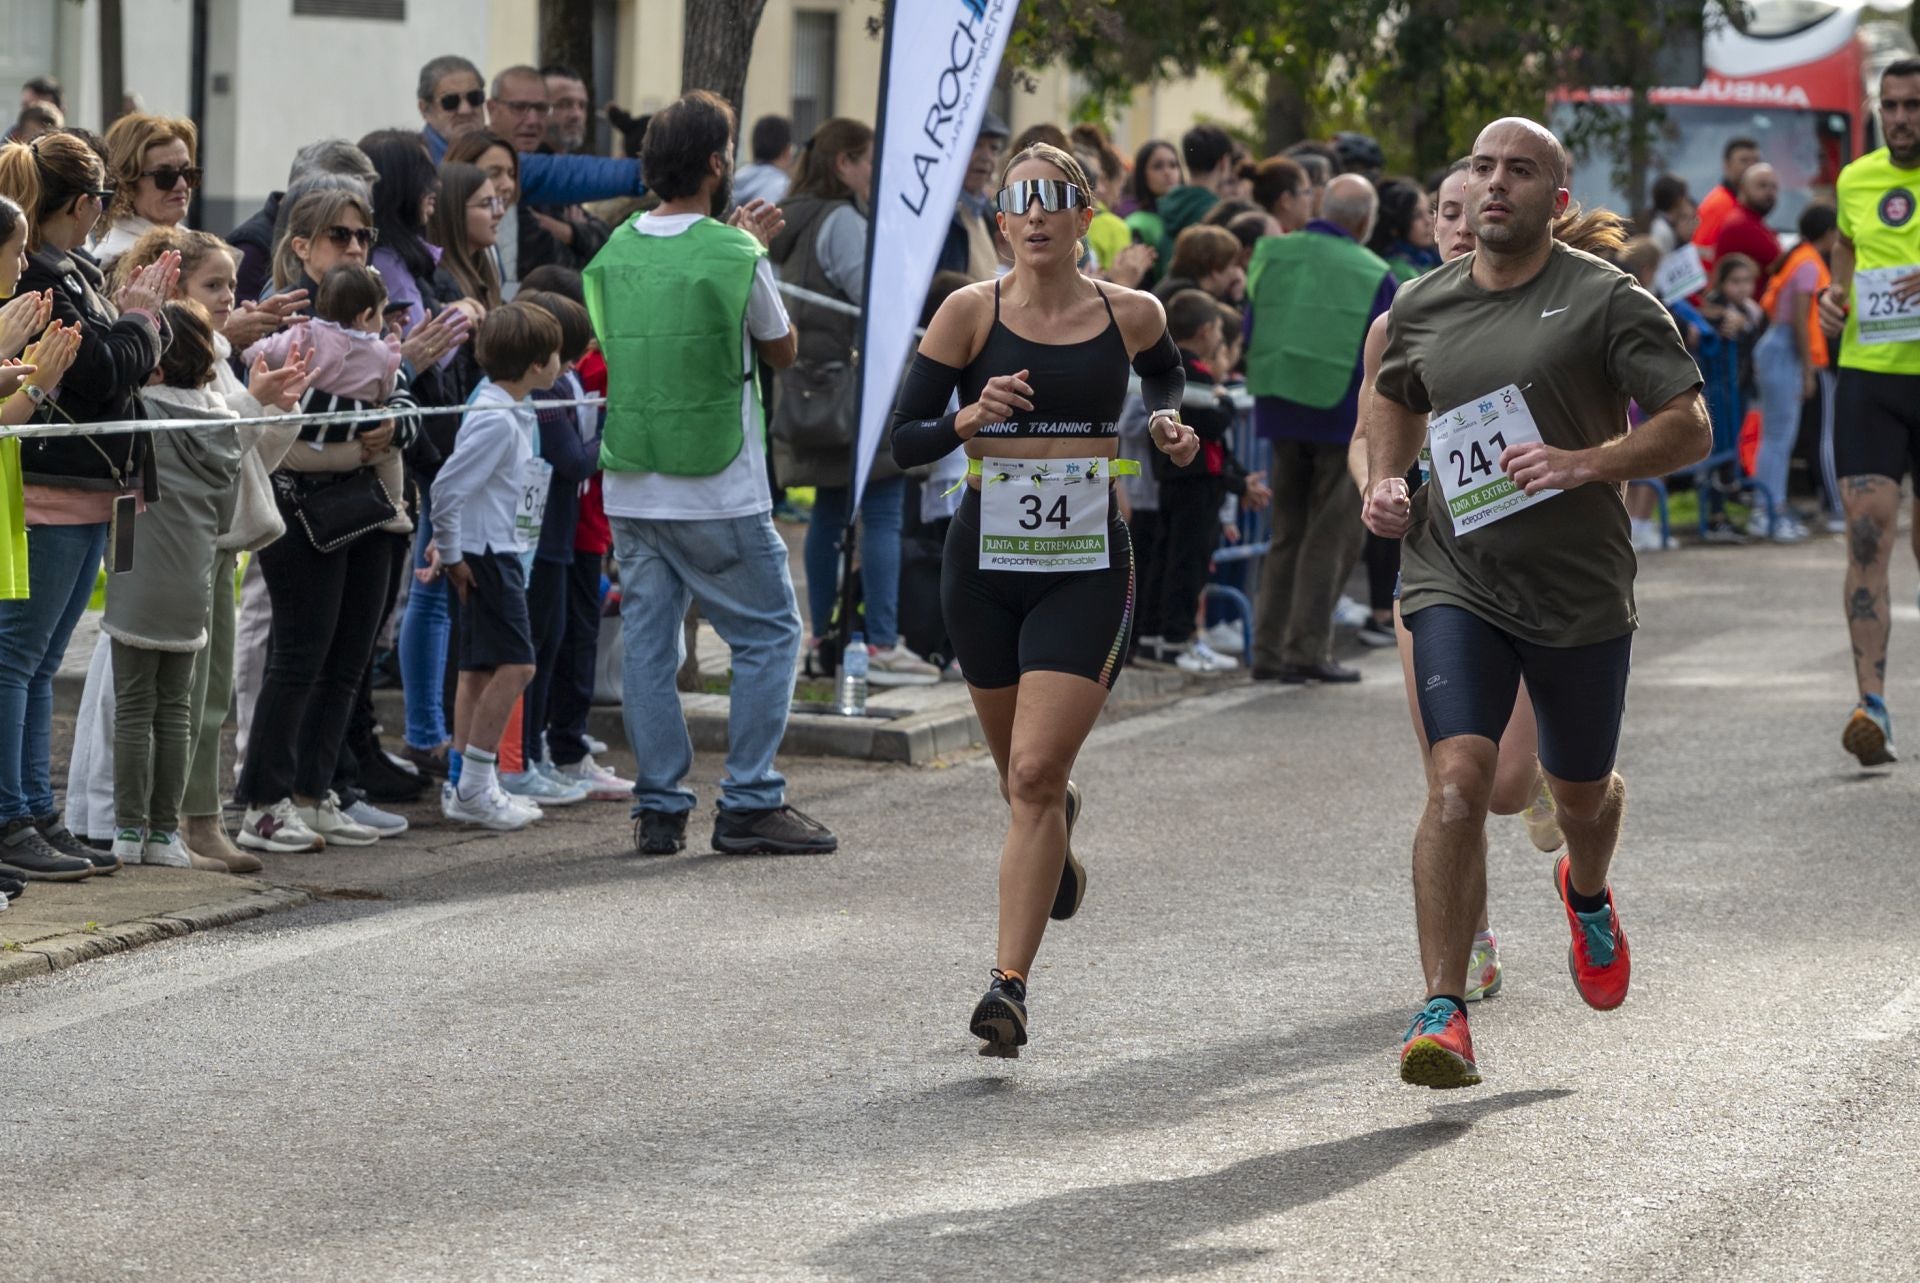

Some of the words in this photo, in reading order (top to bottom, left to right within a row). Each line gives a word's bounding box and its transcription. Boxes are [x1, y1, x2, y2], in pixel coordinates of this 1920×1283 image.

[900, 153, 939, 217] LA
[980, 422, 1019, 433] INING
[1028, 421, 1092, 433] TRAINING
[1450, 431, 1508, 488] 241
[1019, 494, 1071, 530] 34
[1451, 500, 1471, 515] JUNTA
[1472, 492, 1483, 505] DE
[1482, 480, 1516, 501] EXTREM
[1461, 489, 1546, 526] #deporterespons
[986, 539, 1014, 551] JUNTA
[1018, 540, 1030, 551] DE
[1034, 539, 1102, 551] EXTREMADURA
[992, 556, 1097, 567] #deporteresponsable
